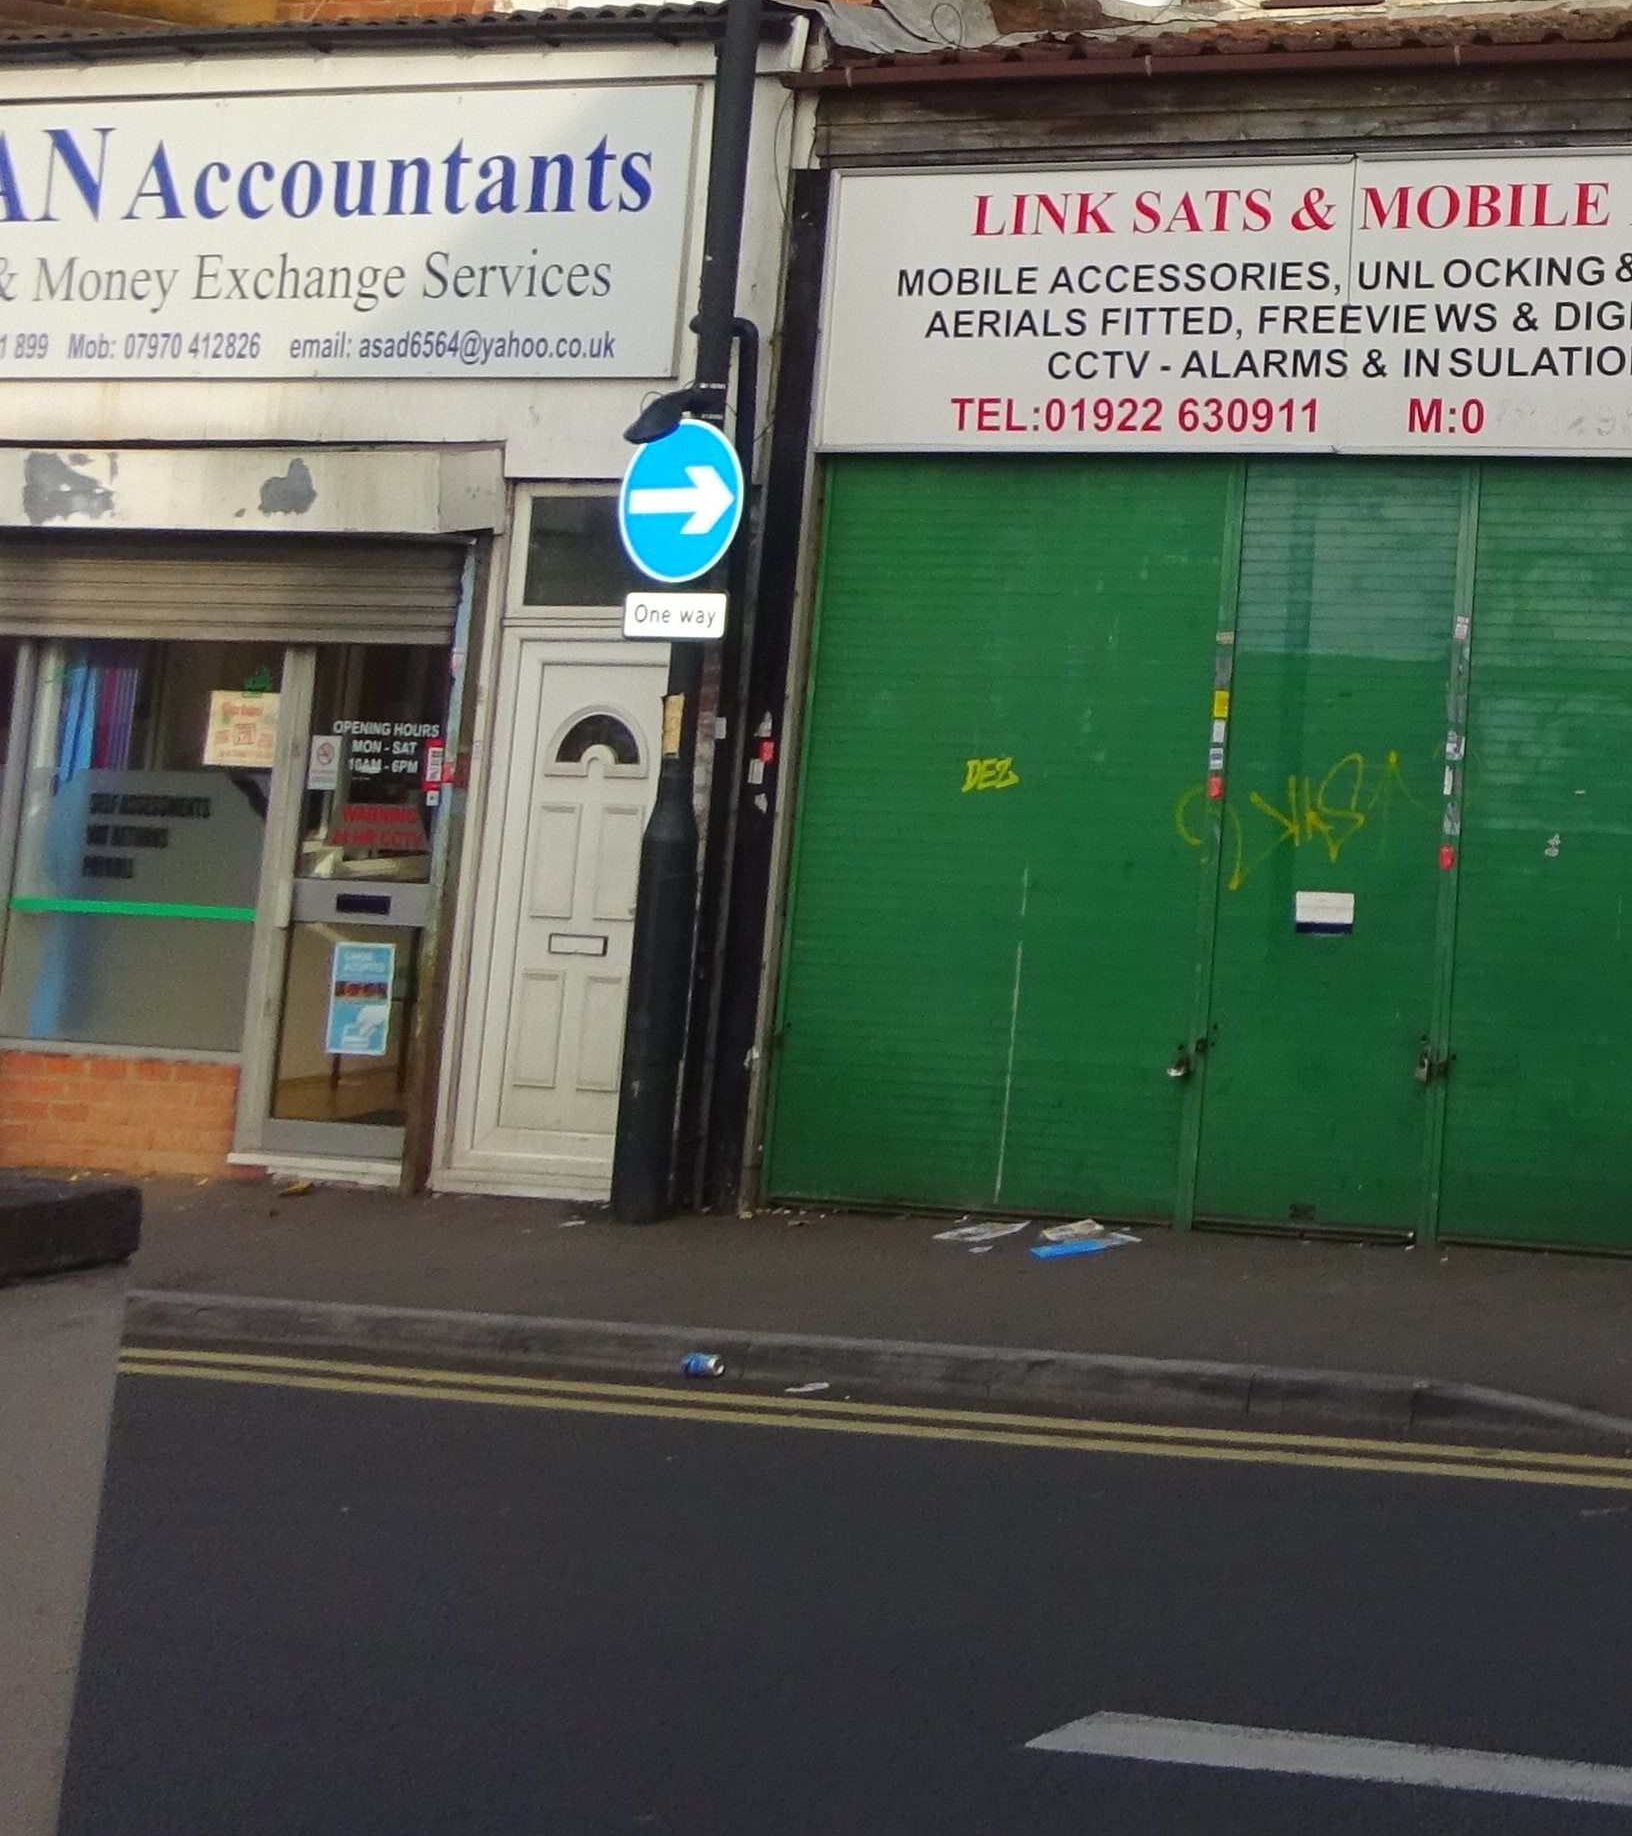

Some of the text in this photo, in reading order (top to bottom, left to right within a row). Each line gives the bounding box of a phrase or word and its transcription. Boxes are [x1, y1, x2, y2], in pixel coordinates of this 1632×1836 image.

[121, 133, 653, 219] Accountants
[971, 192, 1116, 236] LINK
[1132, 188, 1272, 234] SATS
[1291, 186, 1336, 231] &
[1359, 182, 1610, 230] MOBILE
[32, 256, 180, 314] Money
[191, 251, 405, 313] Exchange
[422, 248, 612, 299] Services
[897, 266, 1039, 297] MOBILE
[1048, 261, 1342, 296] ACCESSORIES,
[1358, 255, 1605, 291] UNLOCKING
[924, 308, 1087, 339] AERIALS
[1101, 306, 1243, 341] FITTED,
[1258, 302, 1497, 335] FREEVIEWS
[1512, 301, 1539, 332] &
[14, 333, 49, 359] 899
[68, 332, 116, 359] Mob:
[124, 332, 182, 359] 07970
[188, 332, 261, 359] 412826
[290, 330, 352, 359] email:
[359, 329, 615, 365] asad6564@yahoo.co.uk
[1047, 350, 1150, 380] CCTV
[1180, 348, 1348, 379] ALARMS
[1362, 348, 1388, 379] &
[950, 397, 1163, 432] TEL:01922
[1178, 397, 1318, 433] 630911
[634, 604, 716, 628] One way
[333, 720, 440, 738] OPENING HOURS
[351, 740, 383, 754] MON
[391, 741, 418, 755] SAT
